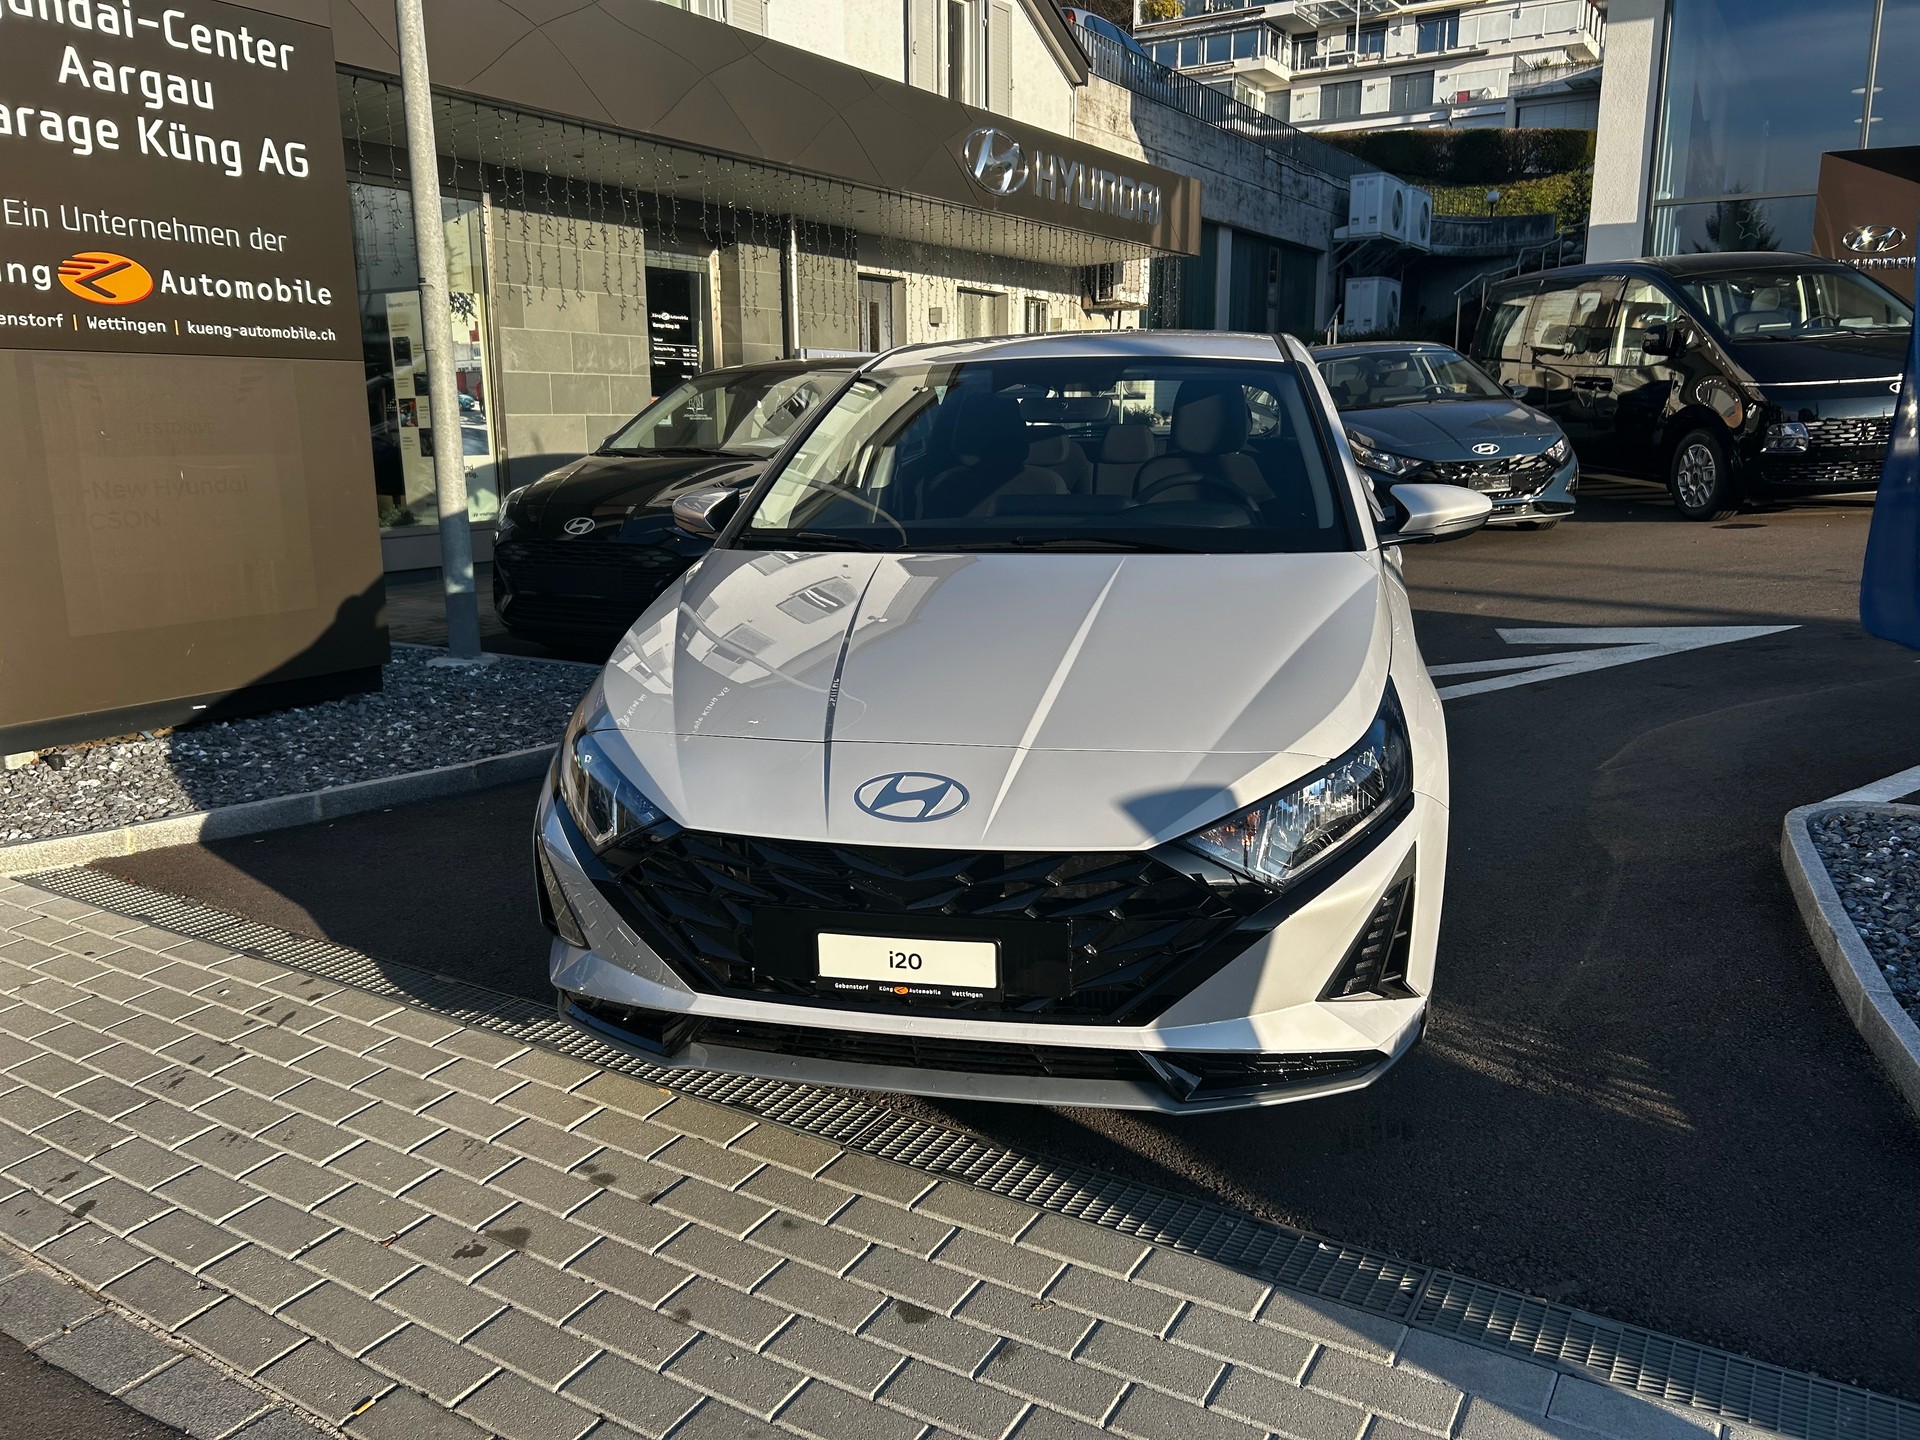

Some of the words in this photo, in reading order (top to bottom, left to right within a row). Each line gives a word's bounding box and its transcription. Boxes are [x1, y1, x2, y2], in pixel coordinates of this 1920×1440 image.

[0, 0, 295, 71] undai-Center
[58, 45, 214, 110] Aargau
[137, 115, 243, 177] Küng
[258, 137, 309, 178] AG
[1034, 150, 1161, 226] HYUNDAI
[3, 198, 49, 229] Ein
[60, 204, 241, 248] Unternehmen
[249, 226, 287, 252] der
[0, 262, 52, 291] ng
[160, 269, 332, 306] Automobile
[1838, 256, 1916, 270] YUNDAI
[86, 315, 167, 335] Wettingen
[186, 320, 336, 341] kueng-automobile.ch
[888, 950, 923, 970] i20
